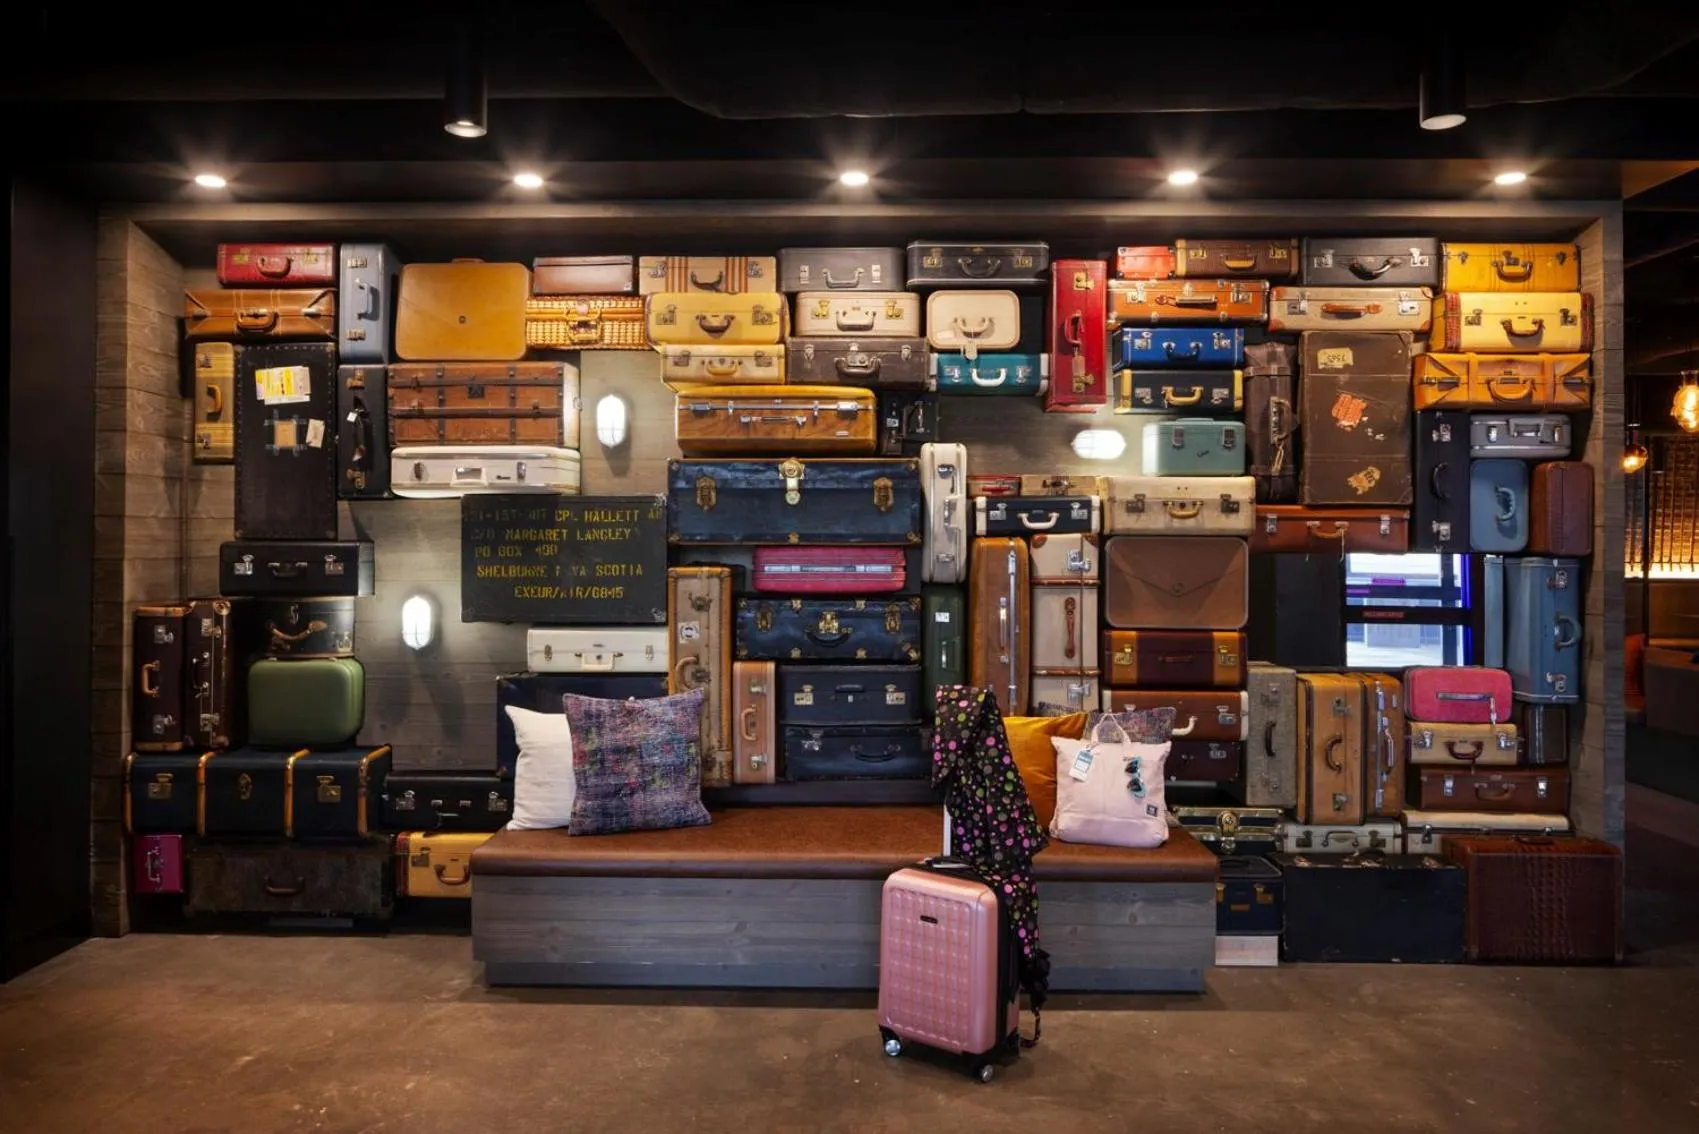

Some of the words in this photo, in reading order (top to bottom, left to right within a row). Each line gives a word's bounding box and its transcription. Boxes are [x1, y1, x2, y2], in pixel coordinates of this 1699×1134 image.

[584, 509, 640, 523] HALLETT
[504, 527, 568, 541] MARGARET
[576, 527, 631, 541] LANGLEY
[475, 545, 491, 558] PO
[498, 545, 522, 558] BOX
[595, 563, 643, 577] SCOTIA
